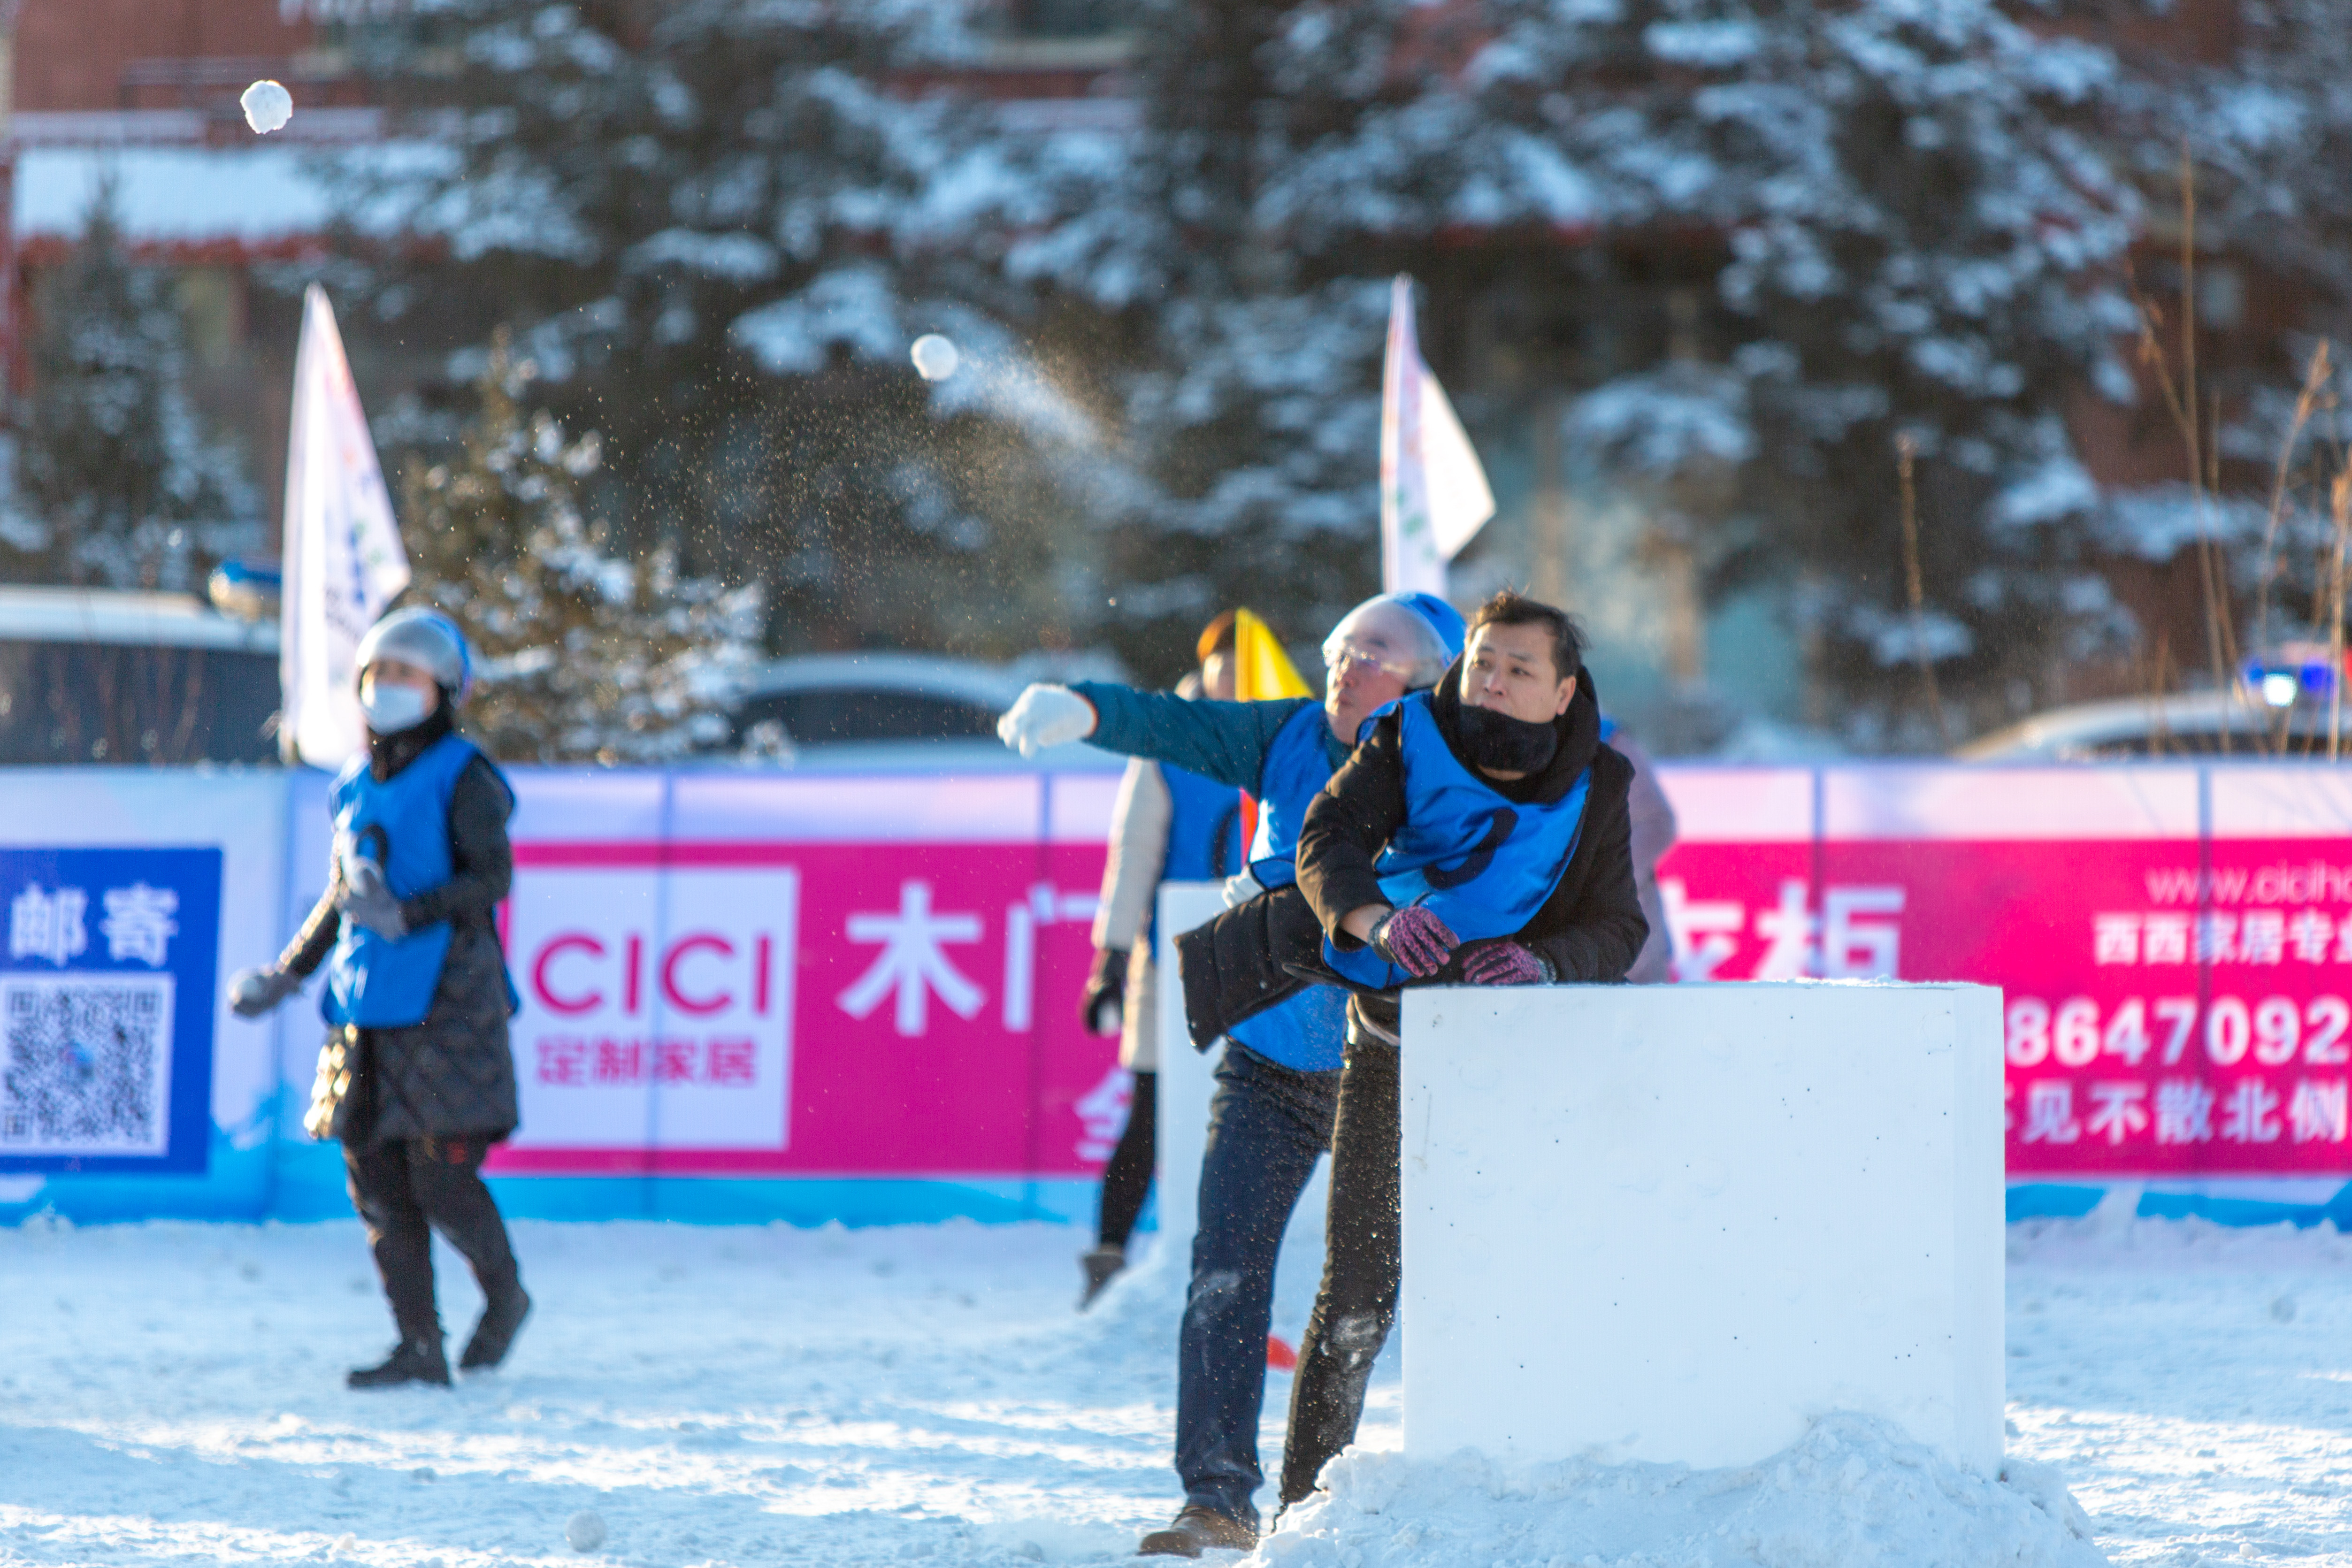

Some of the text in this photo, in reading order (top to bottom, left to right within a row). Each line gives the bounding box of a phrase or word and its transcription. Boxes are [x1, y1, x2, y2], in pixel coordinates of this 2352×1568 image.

[2146, 858, 2352, 903] www.cicih
[11, 882, 179, 967] 邮寄
[531, 932, 771, 1017] CICI
[535, 1035, 757, 1085] 定制家居
[2005, 997, 2349, 1065] 8647092
[2005, 1080, 2346, 1144] 见不散北侧
